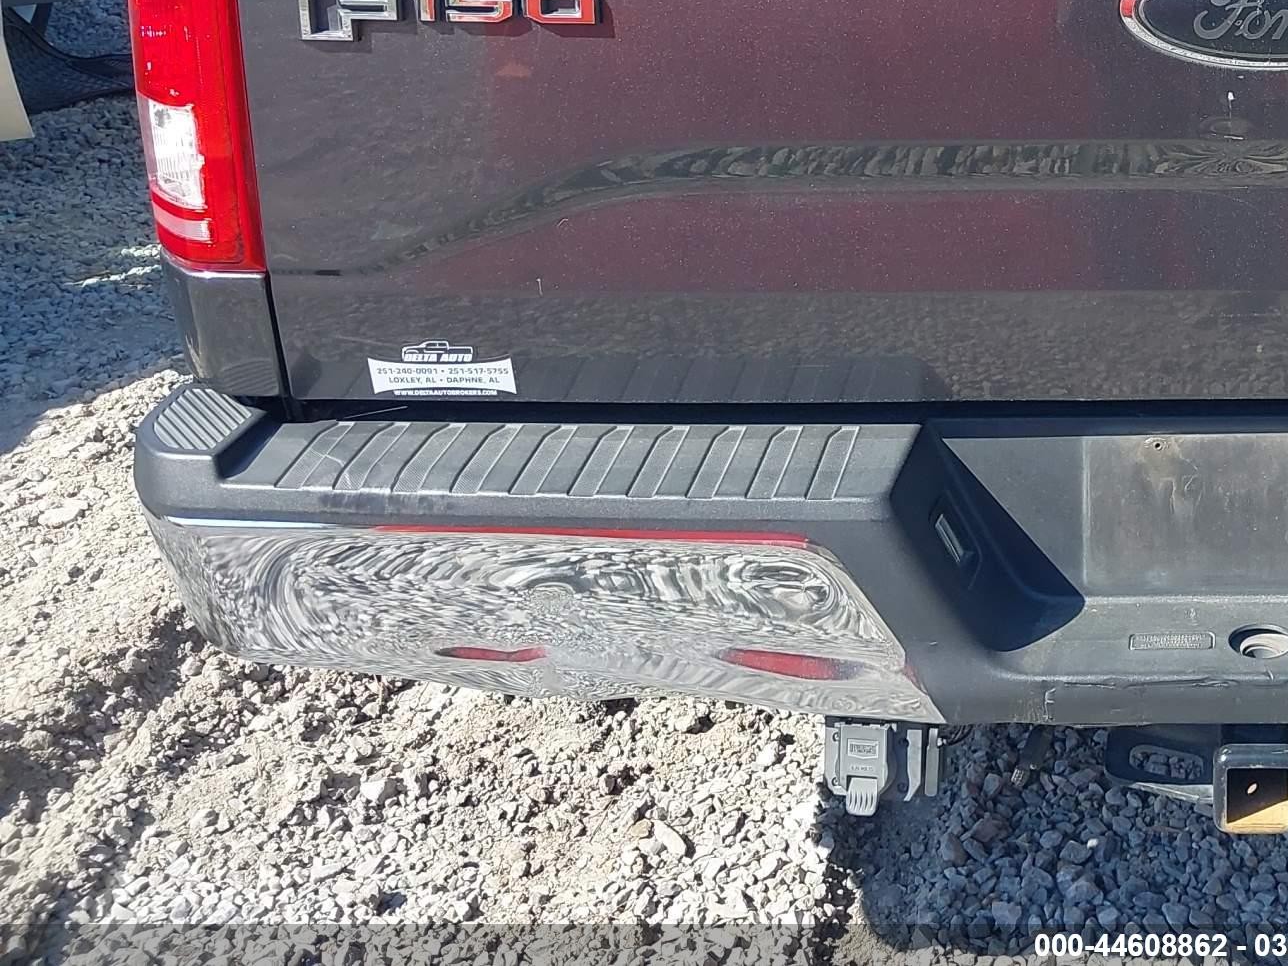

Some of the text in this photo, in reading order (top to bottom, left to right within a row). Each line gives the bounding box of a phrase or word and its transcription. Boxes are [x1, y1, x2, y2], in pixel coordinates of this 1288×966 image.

[403, 353, 473, 362] DELTA AUTO
[425, 376, 437, 384] AL
[488, 376, 500, 384] AL
